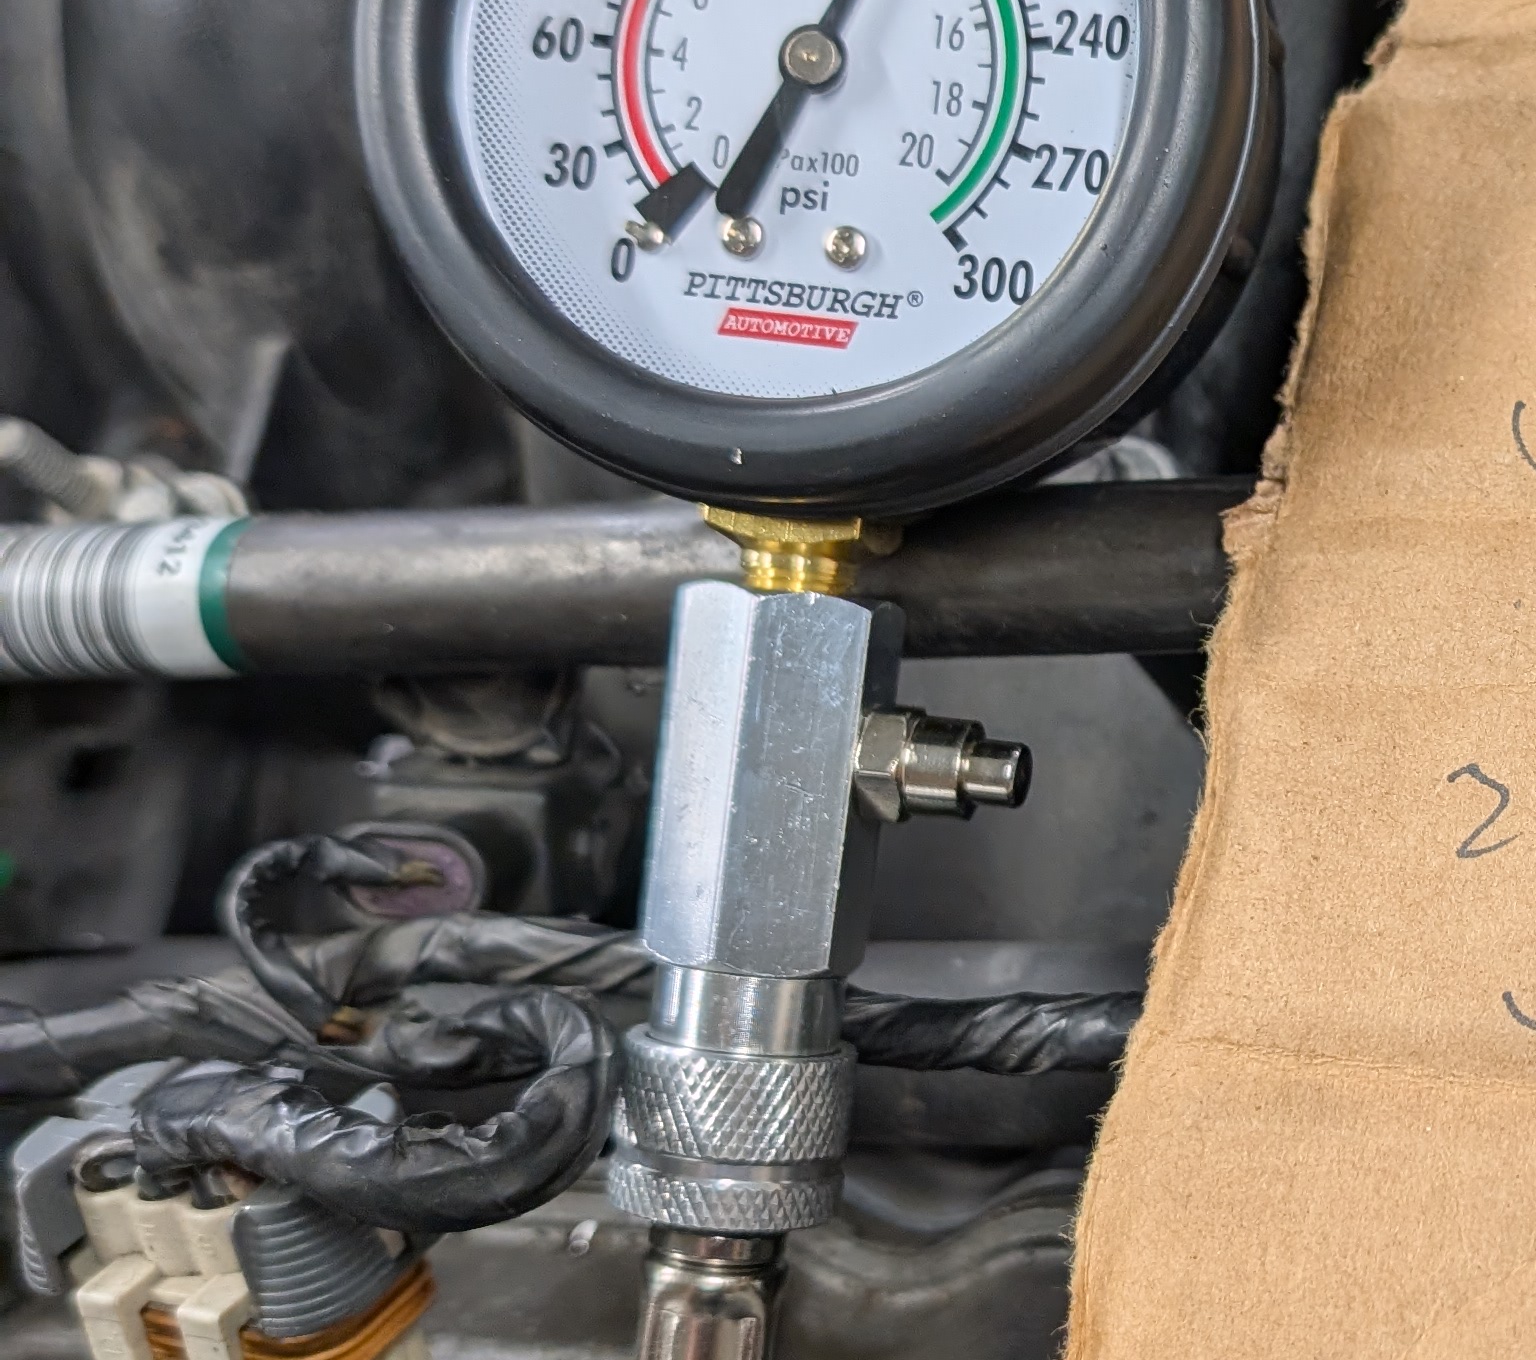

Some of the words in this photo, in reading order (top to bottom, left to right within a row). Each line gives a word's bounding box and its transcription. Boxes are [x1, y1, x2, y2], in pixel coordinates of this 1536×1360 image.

[532, 16, 583, 61] 60
[934, 15, 964, 50] 16
[1052, 10, 1129, 59] 240
[672, 37, 687, 71] 4
[686, 97, 701, 131] 2
[931, 81, 962, 116] 18
[544, 143, 594, 189] 30
[713, 135, 729, 169] 0
[900, 132, 934, 169] 20
[1032, 144, 1108, 195] 270
[779, 180, 829, 215] psi
[610, 239, 635, 282] 0
[953, 255, 1032, 304] 300
[724, 315, 852, 342] AUTOMOTIVE
[1447, 763, 1512, 859] 2
